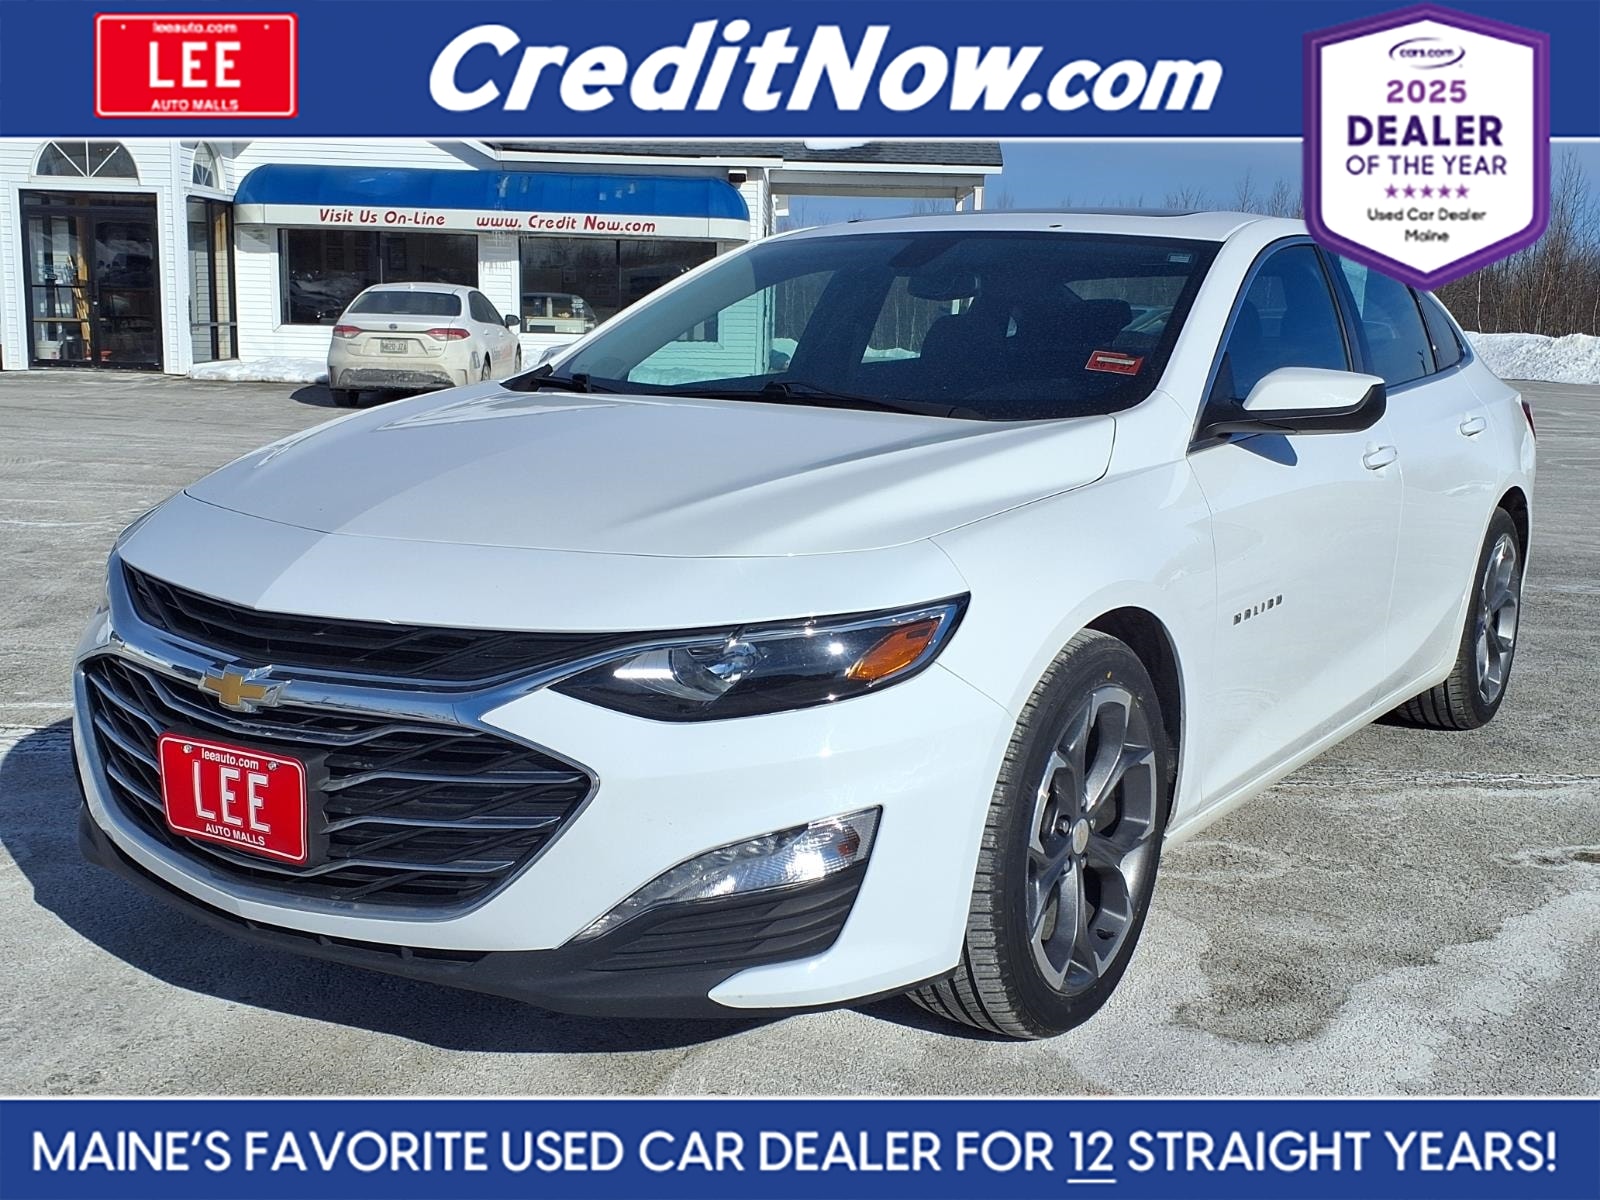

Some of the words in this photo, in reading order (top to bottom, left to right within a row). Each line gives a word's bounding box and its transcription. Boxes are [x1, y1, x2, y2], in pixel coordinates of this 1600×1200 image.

[319, 208, 354, 223] Visit
[359, 210, 378, 224] Us
[384, 211, 446, 226] On-Line
[476, 218, 523, 228] www.
[528, 215, 578, 230] Credit
[583, 216, 656, 233] Now.com
[201, 748, 259, 770] leeauto.com
[192, 760, 271, 834] LEE
[205, 823, 231, 837] AUTO
[232, 831, 266, 846] MALLS
